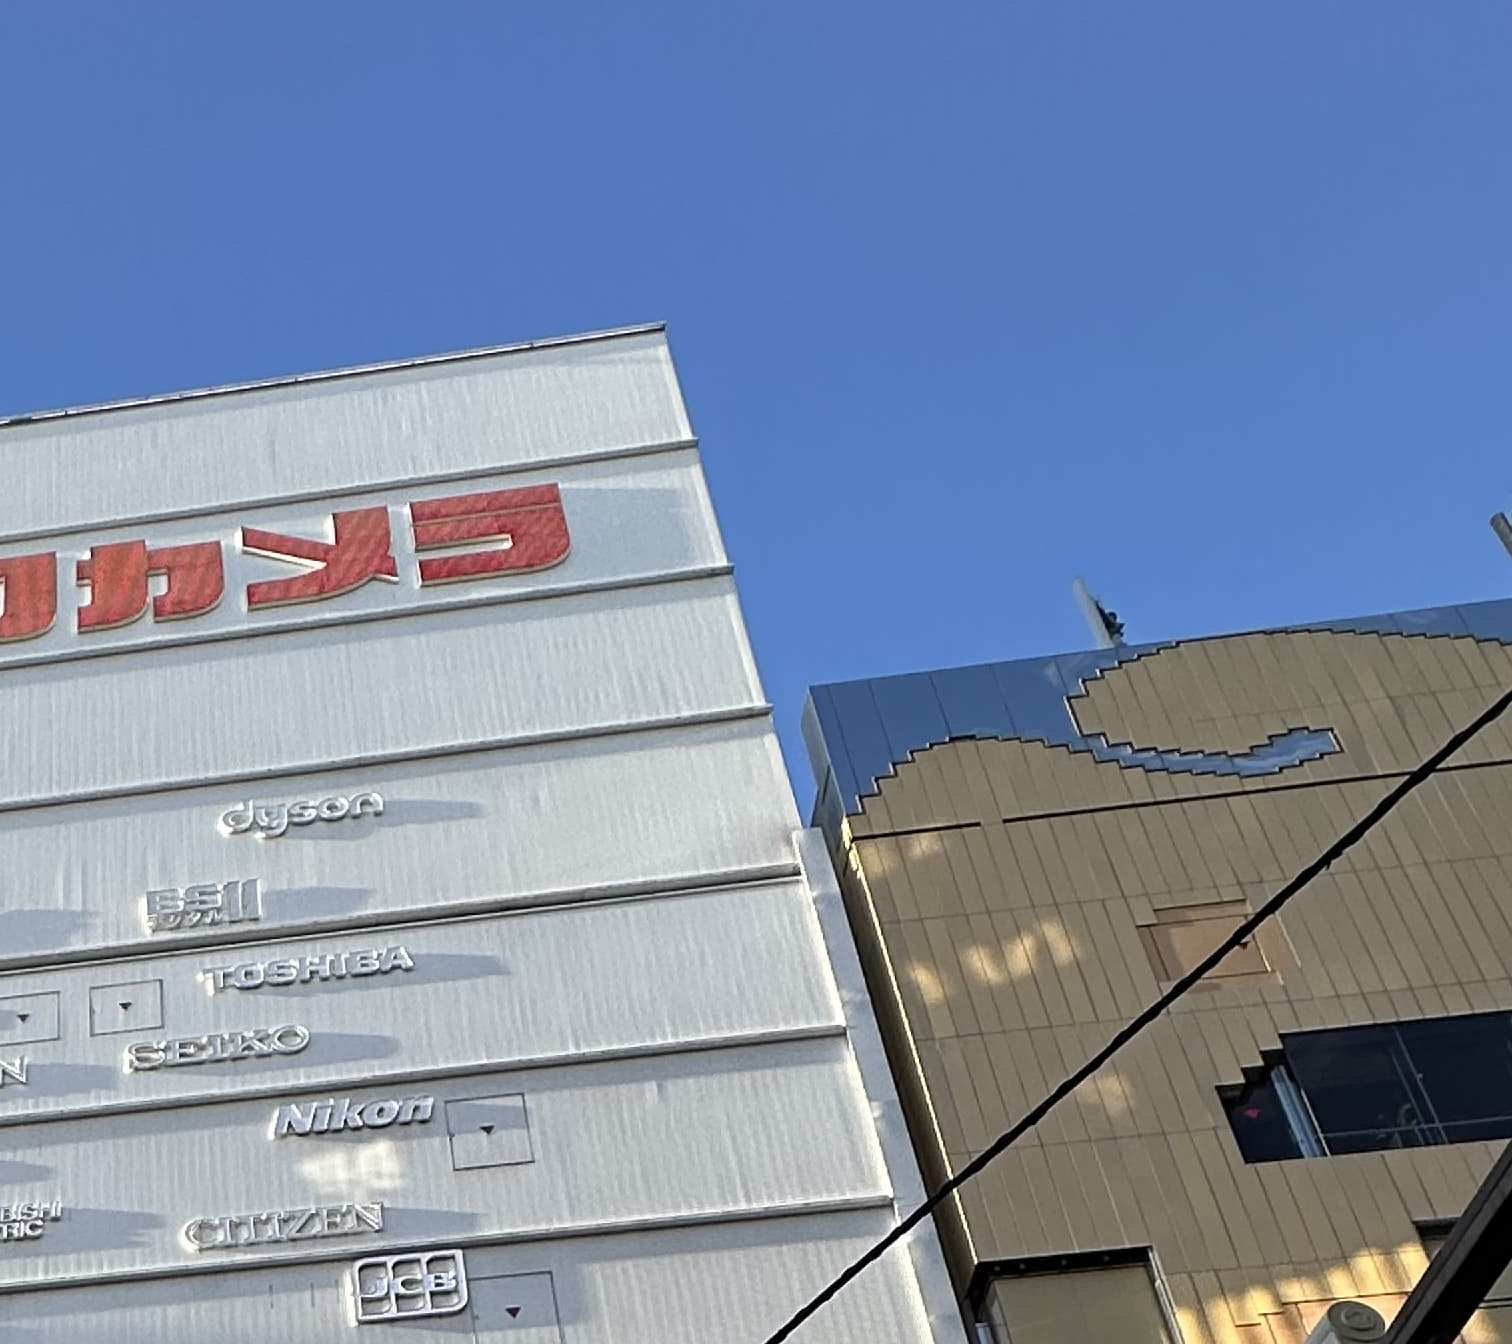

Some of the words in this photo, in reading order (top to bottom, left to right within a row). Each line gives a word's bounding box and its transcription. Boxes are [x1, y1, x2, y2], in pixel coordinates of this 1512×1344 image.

[218, 792, 384, 838] dyson
[203, 946, 415, 994] TOSHIBA
[124, 1024, 312, 1072] SEIKO
[270, 1094, 435, 1139] Nikon
[181, 1202, 385, 1251] CITIZEN
